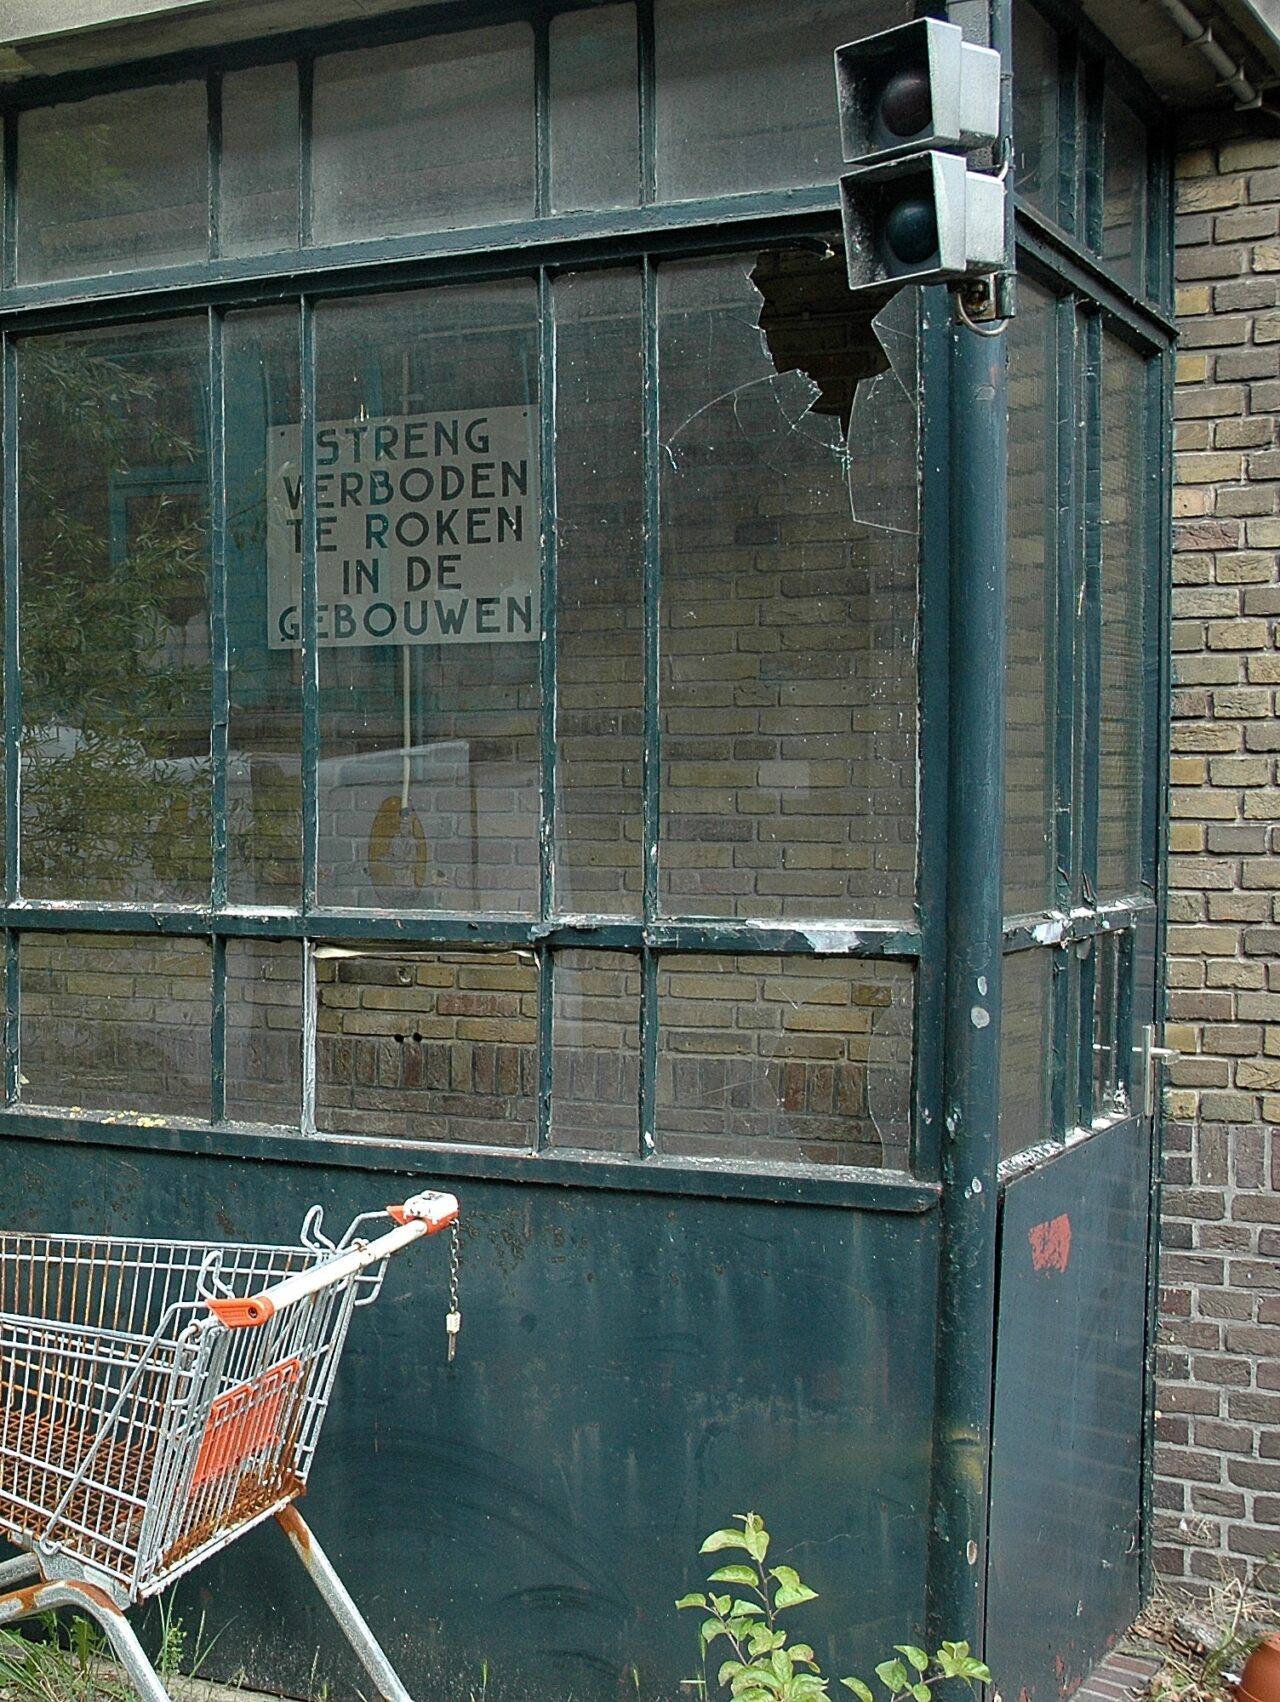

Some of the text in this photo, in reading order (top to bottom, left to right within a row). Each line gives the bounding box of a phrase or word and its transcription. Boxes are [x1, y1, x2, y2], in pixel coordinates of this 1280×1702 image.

[315, 418, 489, 465] STRENG
[283, 460, 528, 510] VERBODEN
[286, 505, 522, 553] TE ROKEN
[342, 554, 462, 594] IN DE
[278, 595, 532, 640] GEBOUWEN
